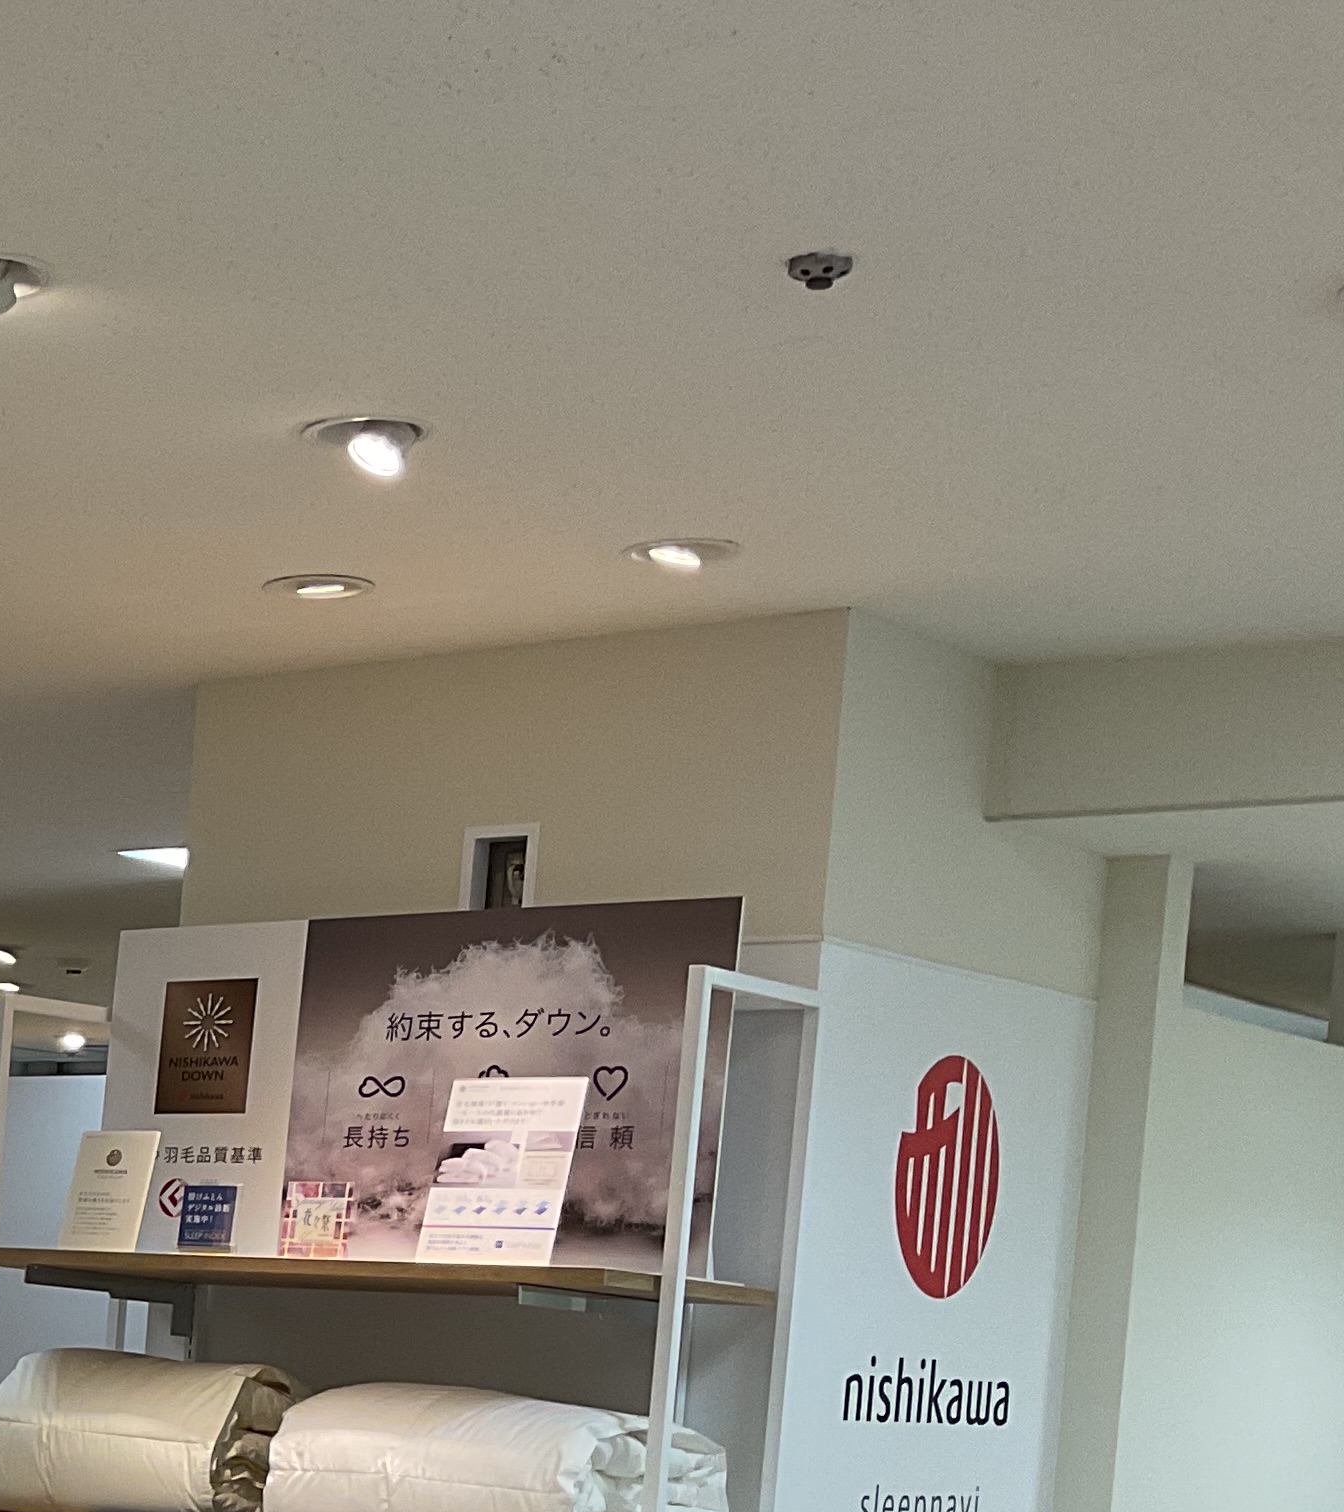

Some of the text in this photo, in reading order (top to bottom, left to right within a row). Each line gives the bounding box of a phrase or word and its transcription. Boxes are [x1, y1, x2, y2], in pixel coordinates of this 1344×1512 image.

[385, 1008, 611, 1042] 約束する、ダウン。
[169, 1056, 239, 1068] NISHIKAWA
[181, 1070, 224, 1081] DOWN
[343, 1125, 411, 1149] 長持ち
[156, 1146, 263, 1164] 羽毛品質基準
[184, 1231, 203, 1240] SLEEP
[843, 1356, 1011, 1427] nishikawa
